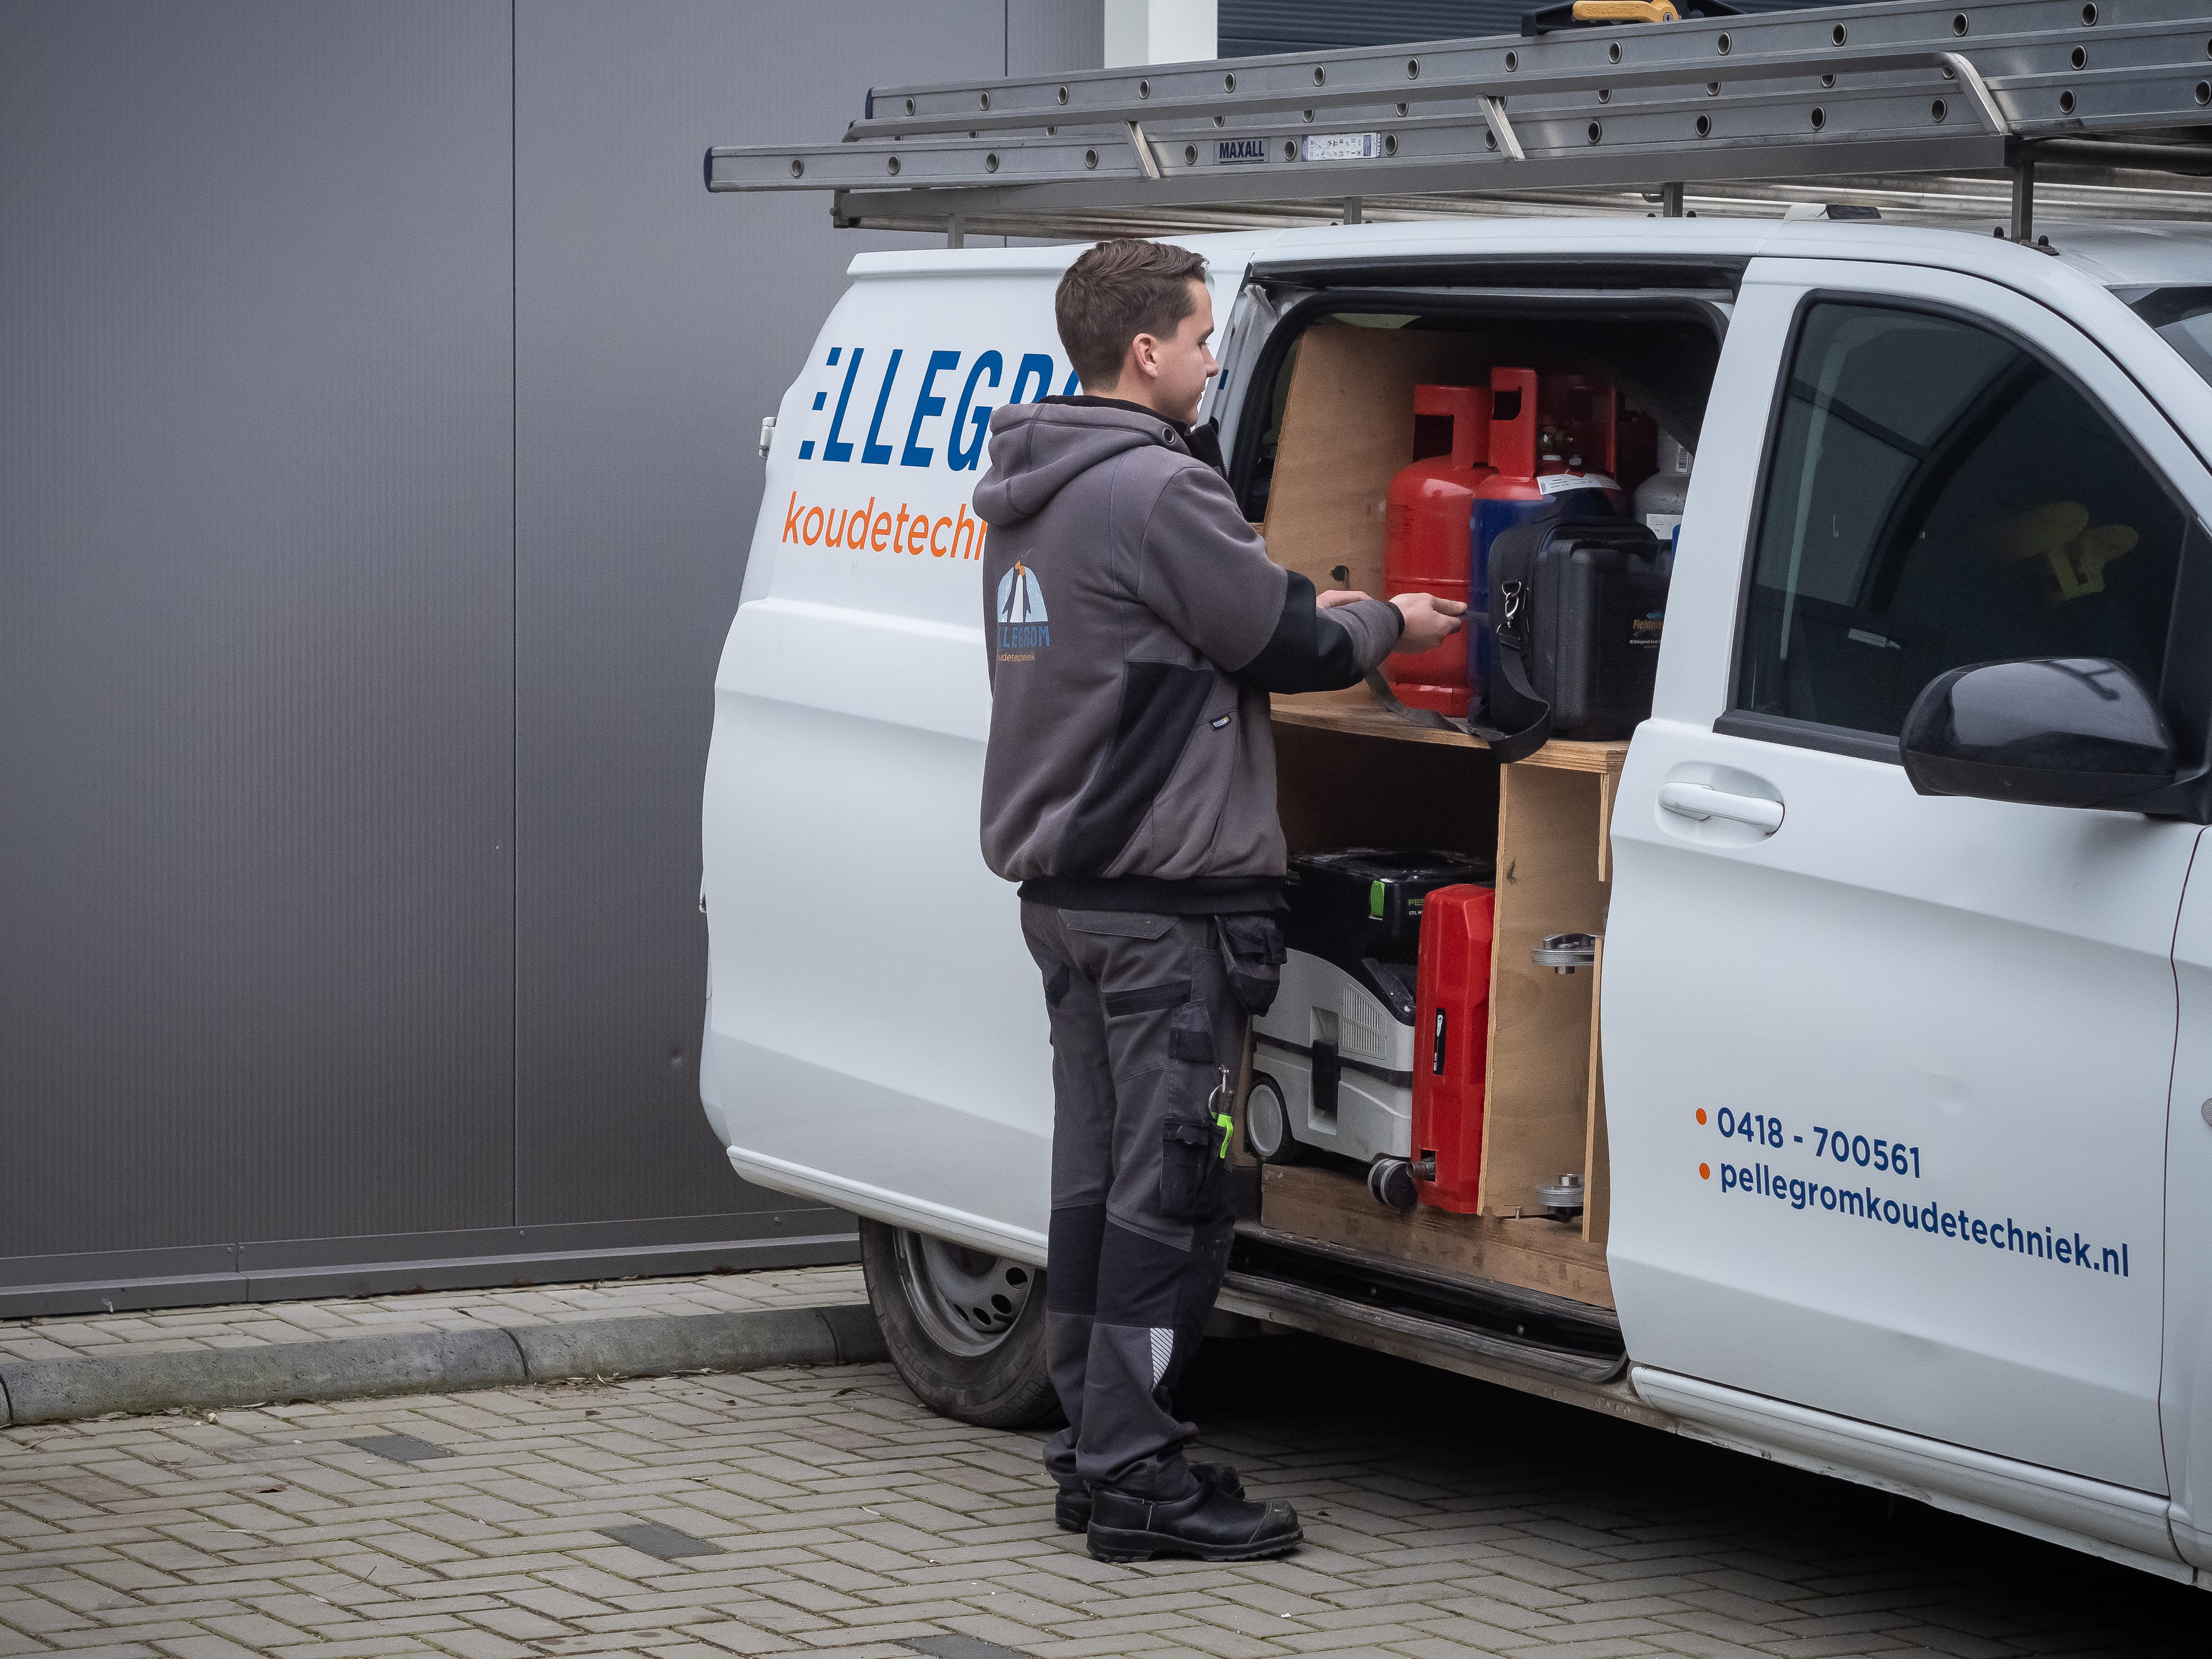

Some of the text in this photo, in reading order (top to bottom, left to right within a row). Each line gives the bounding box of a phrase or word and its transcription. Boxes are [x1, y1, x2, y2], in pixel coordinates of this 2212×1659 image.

[1219, 140, 1264, 158] MAXALL
[1717, 1107, 1784, 1148] 0418
[1813, 1126, 1920, 1179] 700561
[1720, 1162, 2128, 1278] pellegromkoudetechniek.nl
